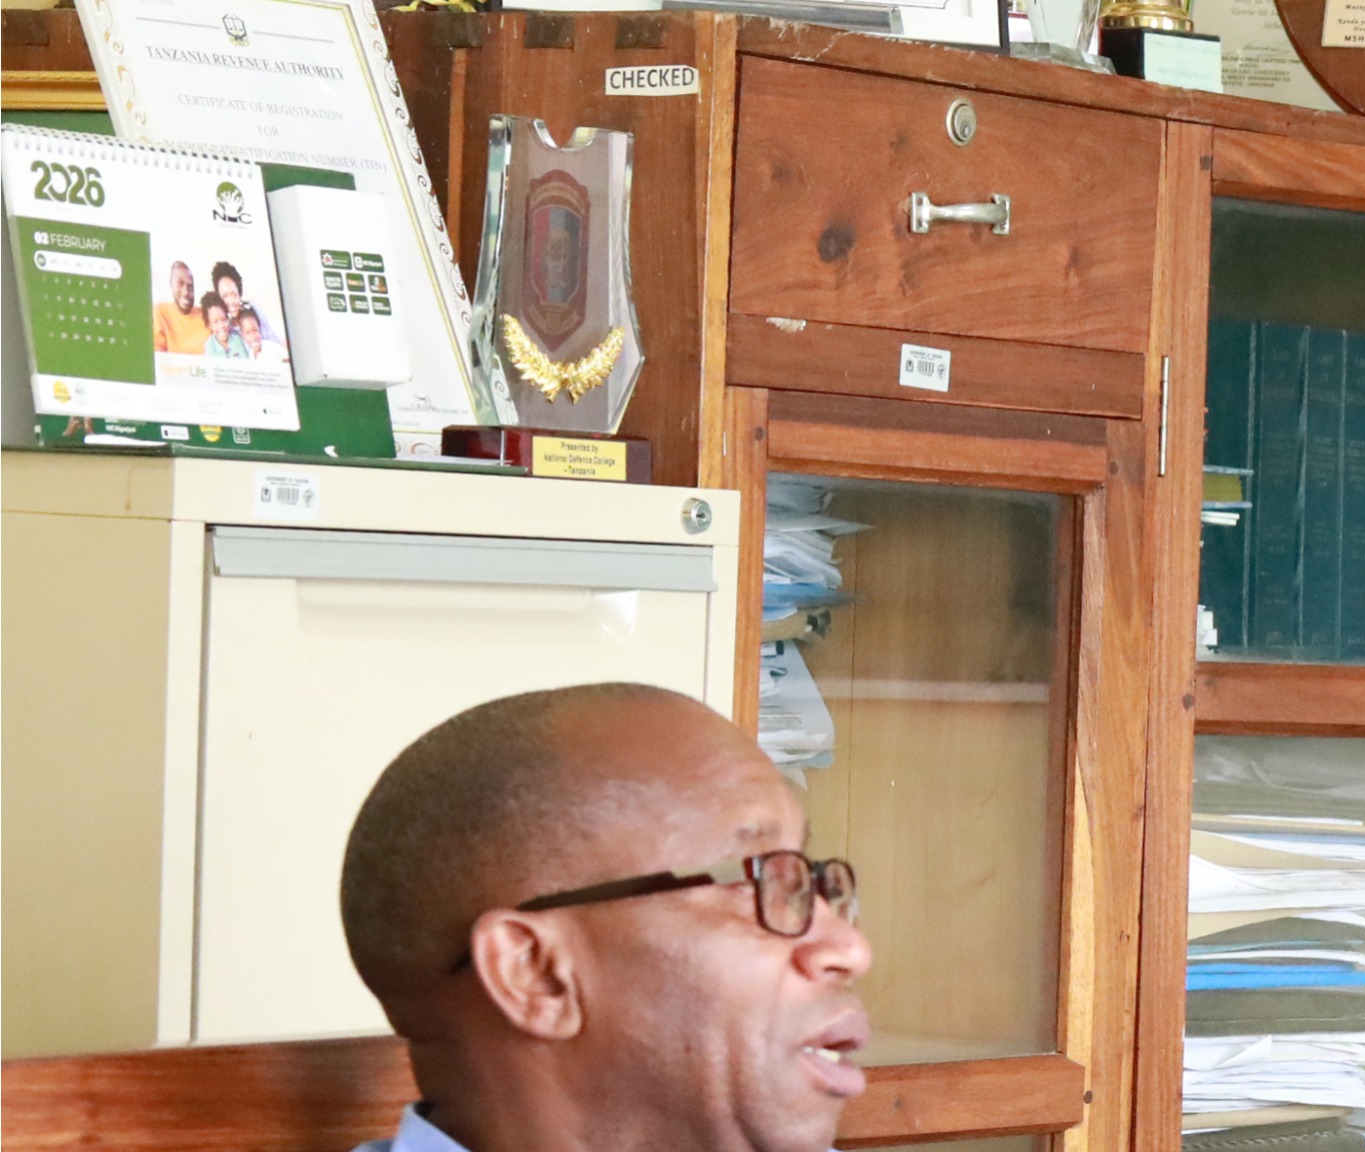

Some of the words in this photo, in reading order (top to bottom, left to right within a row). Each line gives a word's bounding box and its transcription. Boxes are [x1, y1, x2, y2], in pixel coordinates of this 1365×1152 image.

[145, 46, 213, 64] TANZANIA
[212, 54, 272, 71] REVENUE
[274, 61, 345, 80] AUTHORITY
[609, 67, 694, 89] CHECKED
[178, 94, 248, 112] CERTIFICATE
[249, 101, 263, 113] OF
[267, 103, 344, 121] REGISTRATION
[257, 125, 280, 138] FOR
[30, 160, 105, 208] 2026
[50, 233, 107, 251] FEBRUARY
[561, 441, 590, 452] Presented
[569, 466, 596, 477] Tanzania
